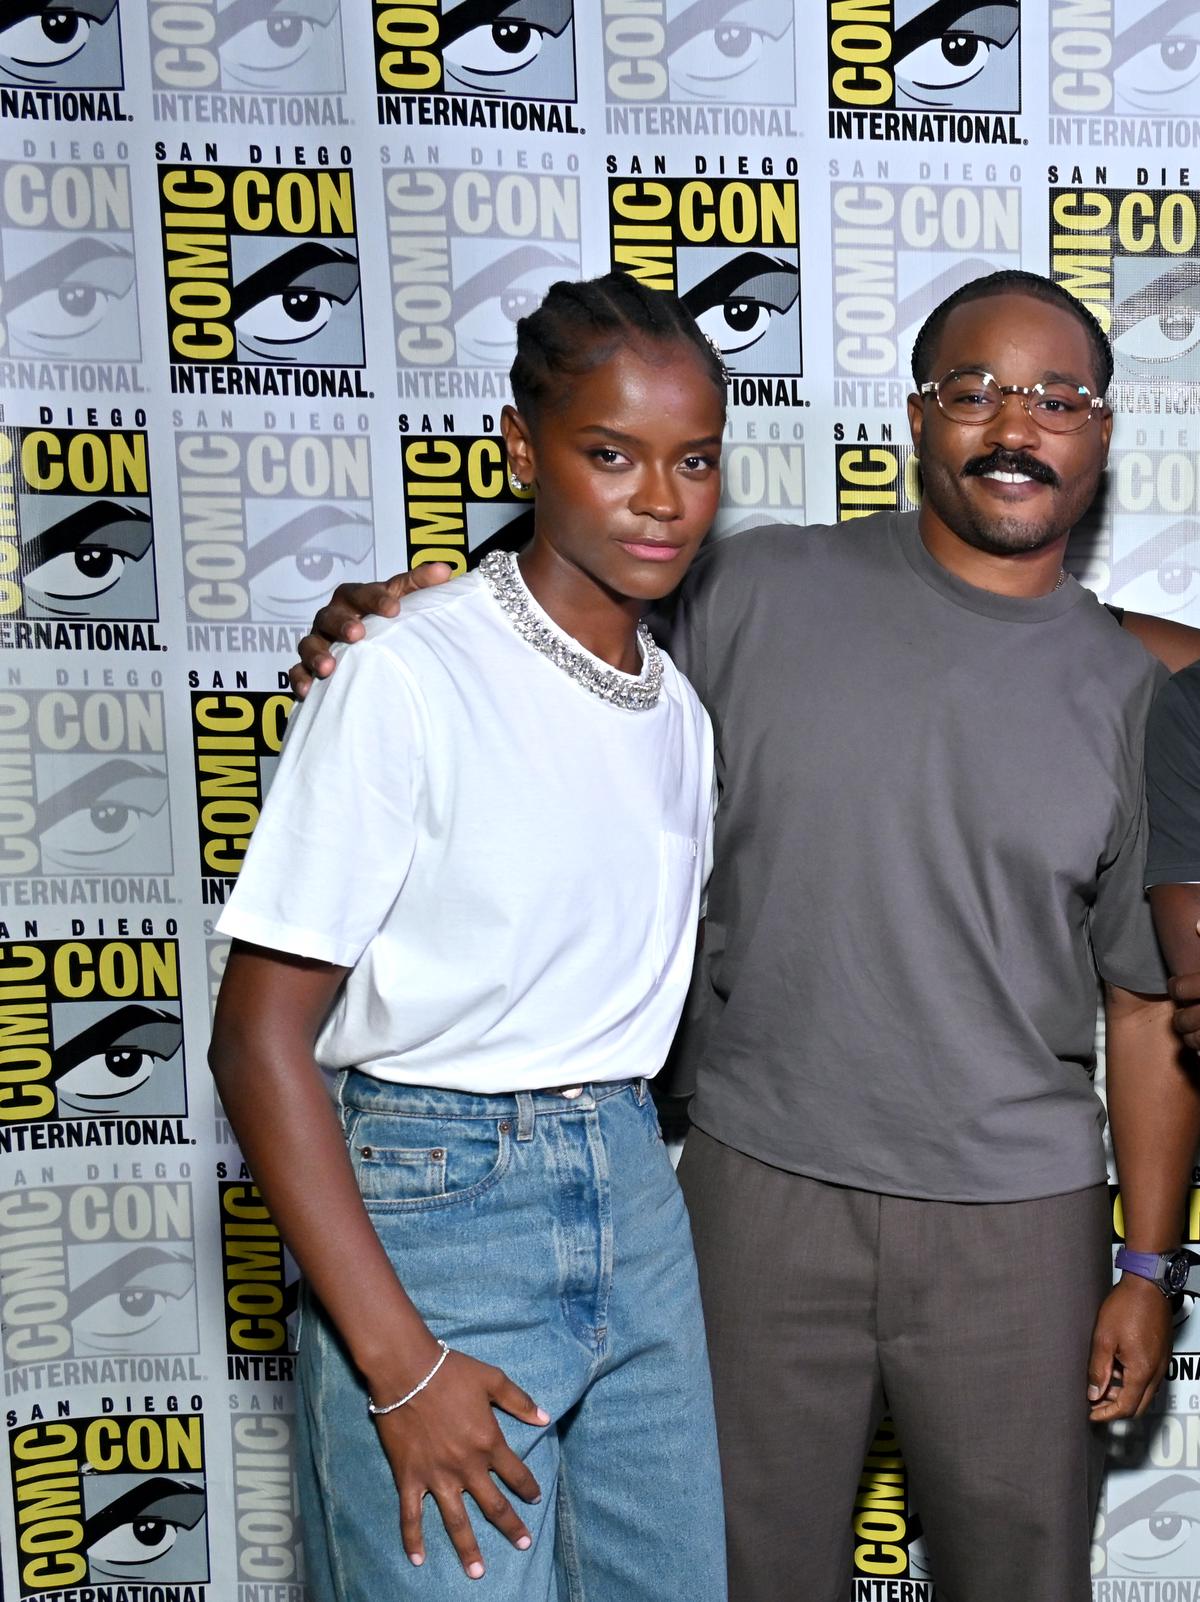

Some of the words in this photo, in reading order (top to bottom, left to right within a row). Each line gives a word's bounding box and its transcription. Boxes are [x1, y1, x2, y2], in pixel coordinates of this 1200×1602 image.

[23, 140, 129, 159] DIEGO
[156, 143, 218, 162] SAN
[250, 145, 352, 165] DIEGO
[380, 145, 440, 164] SAN
[471, 148, 580, 171] DIEGO
[606, 156, 665, 173] SAN
[695, 156, 798, 176] DIEGO
[828, 160, 888, 179] SAN
[920, 162, 1022, 182] DIEGO
[1048, 166, 1106, 184] SAN
[2, 165, 131, 230] CON
[232, 170, 354, 233] CON
[452, 176, 579, 239] CON
[679, 181, 797, 244] CON
[900, 188, 1019, 251] CON
[162, 169, 234, 360] COMIC
[613, 182, 674, 290] MIC
[387, 173, 456, 365] COMIC
[833, 188, 895, 375] COMIC
[40, 407, 148, 427] DIEGO
[173, 410, 233, 428] SAN
[264, 411, 369, 432] DIEGO
[398, 414, 455, 433] SAN
[729, 423, 804, 439] IEGO
[834, 424, 892, 442] SAN
[21, 431, 147, 493] CON
[246, 435, 370, 497] CON
[733, 446, 802, 506] ON
[178, 435, 251, 620] COMIC
[56, 669, 163, 688] DIEGO
[188, 671, 248, 688] SAN
[37, 693, 164, 752] CON
[71, 918, 178, 936] DIEGO
[53, 942, 179, 998] CON
[0, 945, 55, 1120] COMIC
[87, 1163, 191, 1182] DIEGO
[68, 1182, 193, 1242] CON
[0, 1190, 71, 1363] COMIC
[222, 1186, 285, 1351] COMIC
[7, 1400, 70, 1427] SAN
[102, 1395, 203, 1413] DIEGO
[230, 1394, 284, 1412] SAN
[84, 1417, 202, 1469] CON
[13, 1423, 89, 1586] COMIC
[232, 1416, 291, 1580] COMIC
